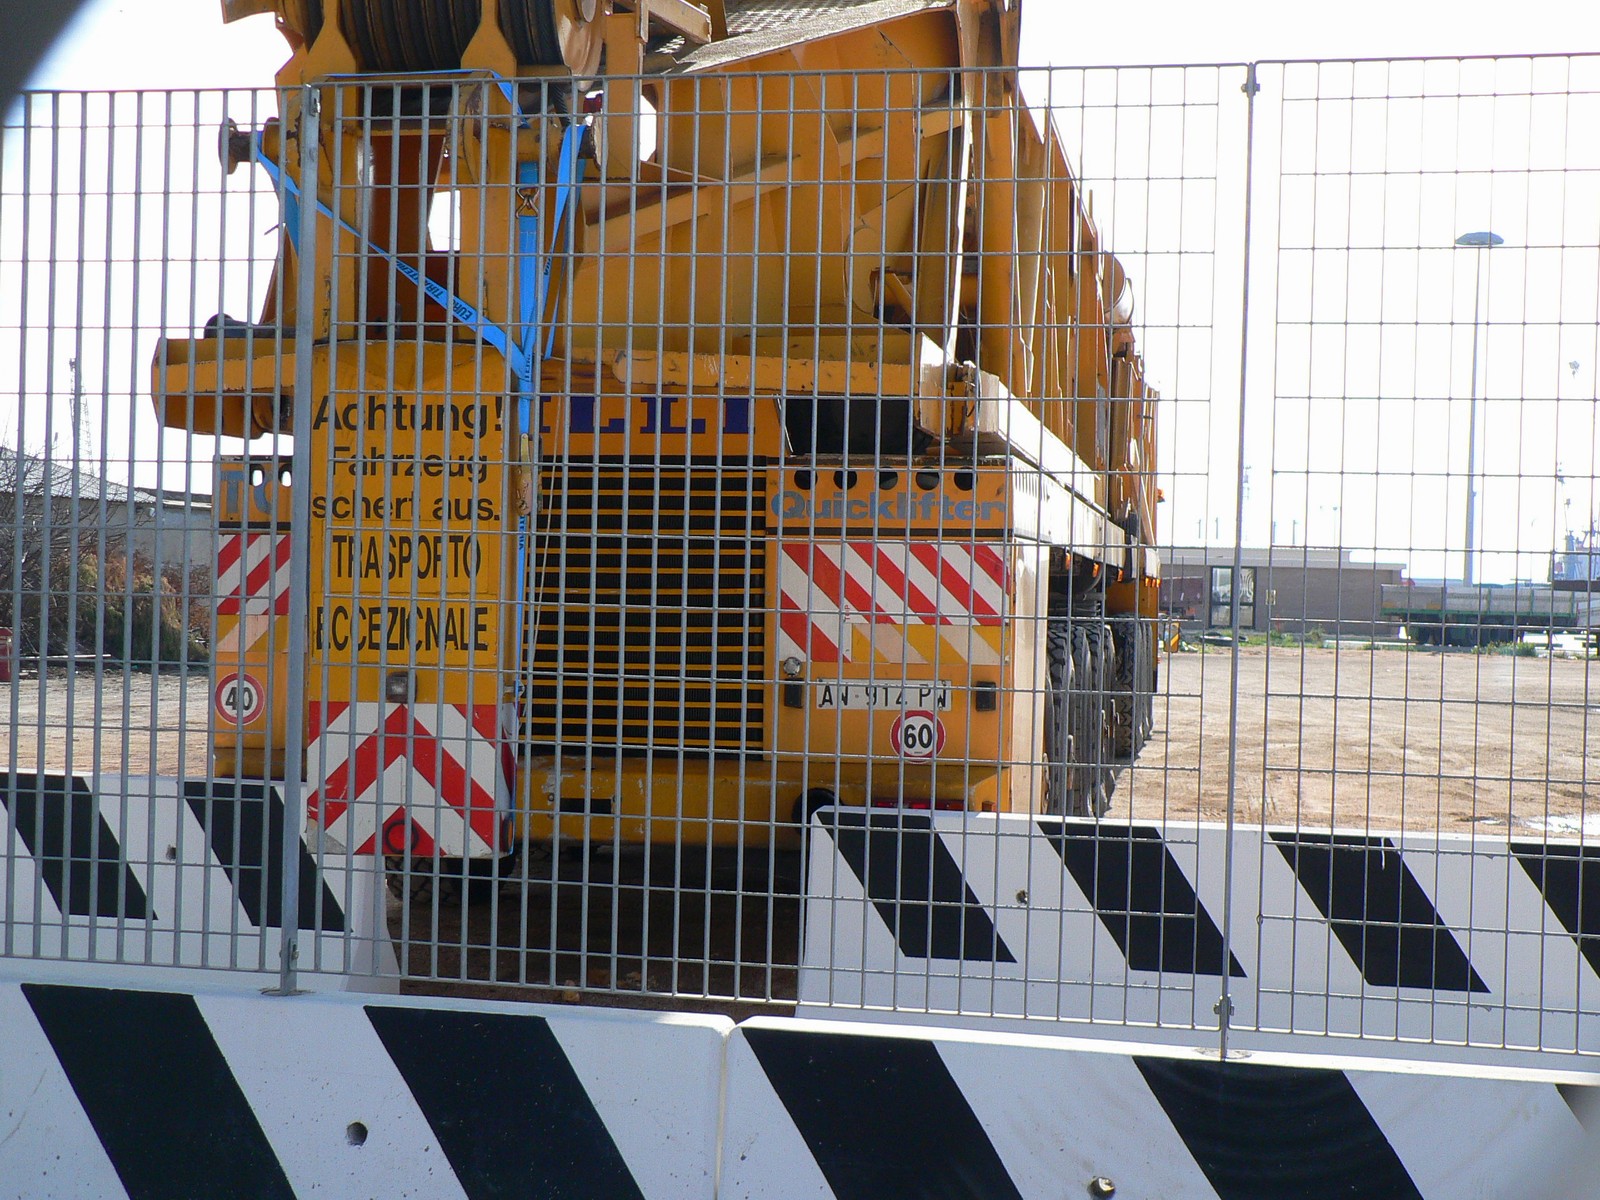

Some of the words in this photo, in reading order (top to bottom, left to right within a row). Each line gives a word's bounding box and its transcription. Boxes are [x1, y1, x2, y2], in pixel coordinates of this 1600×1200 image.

[313, 396, 503, 440] Achtung!
[332, 446, 488, 484] Fahrzeug
[312, 489, 421, 520] schert
[432, 495, 501, 521] aus.
[771, 490, 1007, 521] Quicklifter
[332, 534, 482, 580] TRASPORTO
[316, 605, 489, 651] ECCEZIONALE
[225, 686, 254, 711] 40
[903, 723, 933, 749] 60
